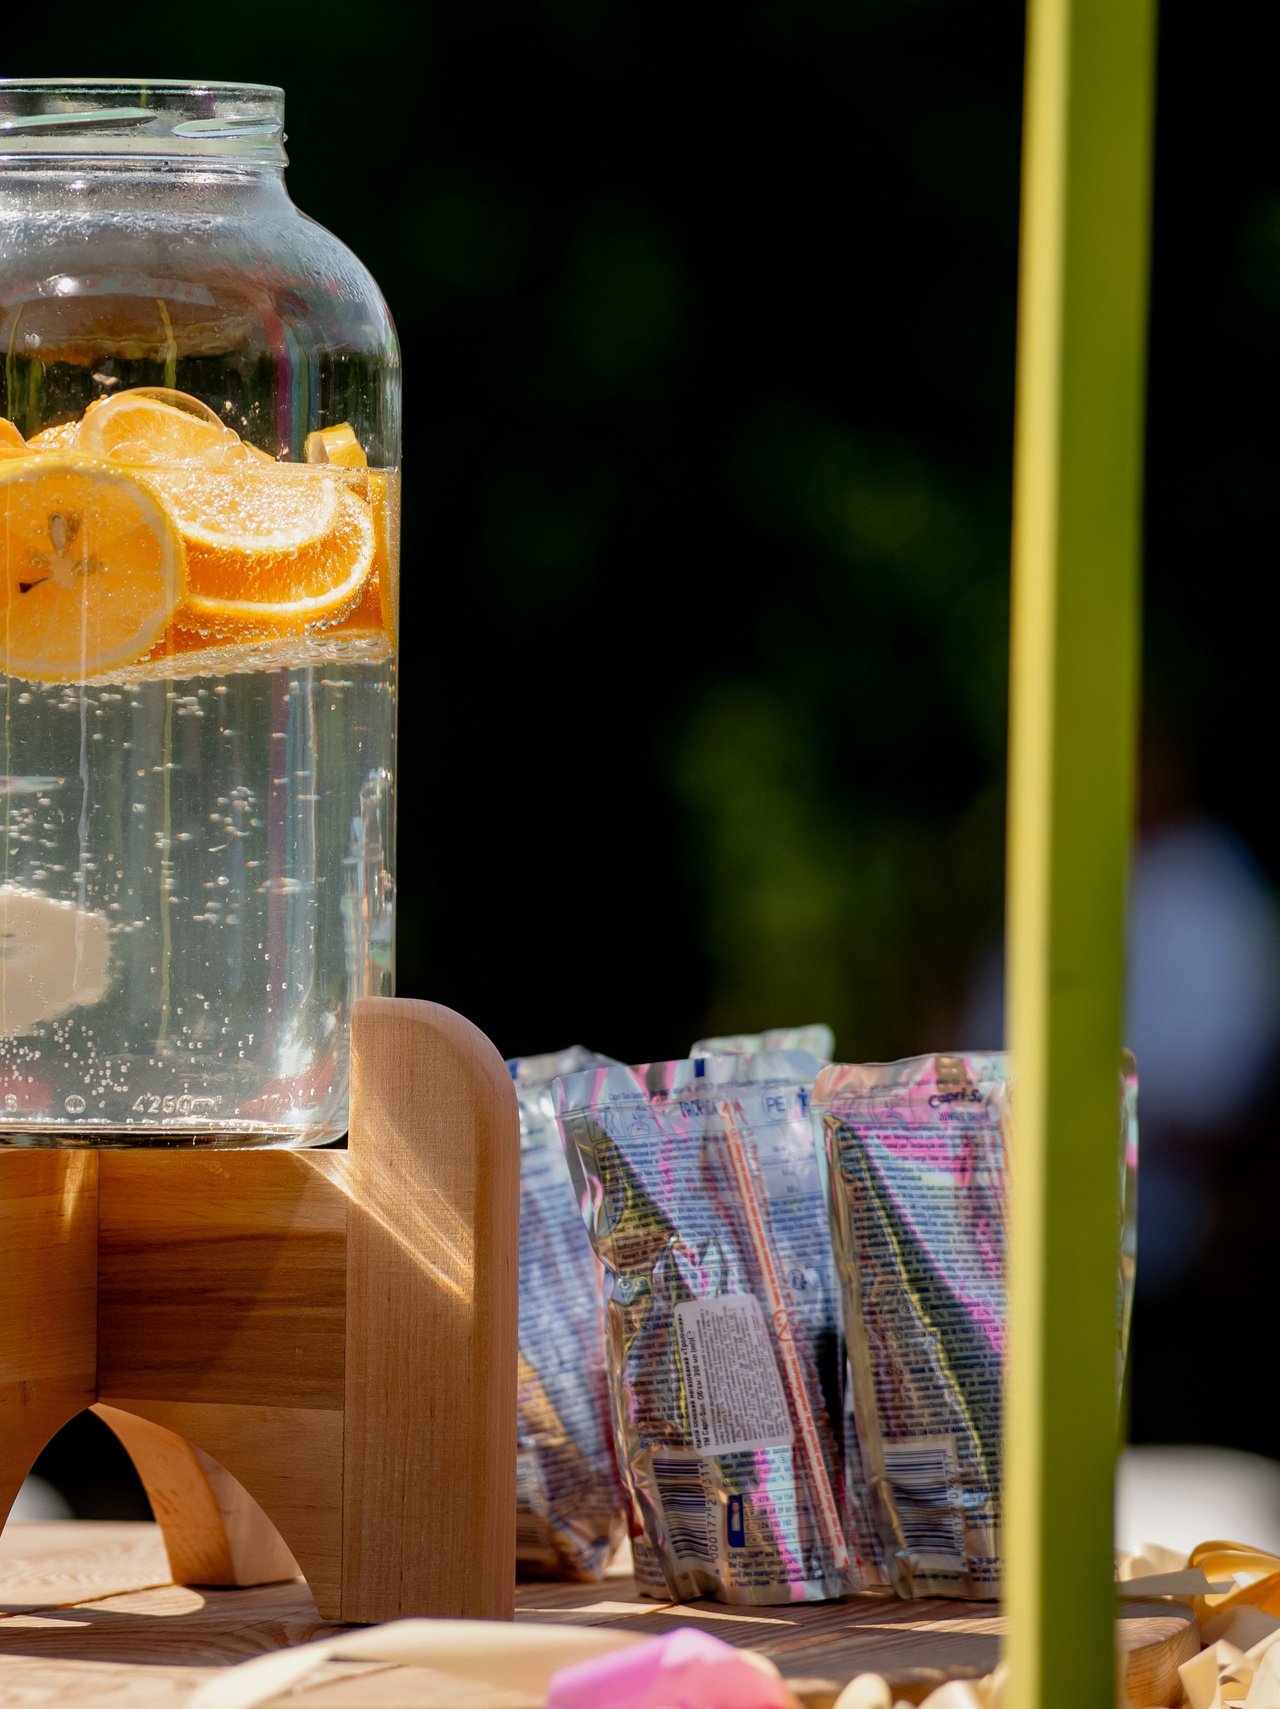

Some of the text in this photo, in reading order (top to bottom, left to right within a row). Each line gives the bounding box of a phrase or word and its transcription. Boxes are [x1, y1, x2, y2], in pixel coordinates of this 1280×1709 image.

[766, 1095, 785, 1113] PE
[683, 1356, 694, 1398] негазований
[692, 1364, 700, 1376] 200
[689, 1400, 698, 1427] соковий
[706, 1512, 719, 1560] 000177
